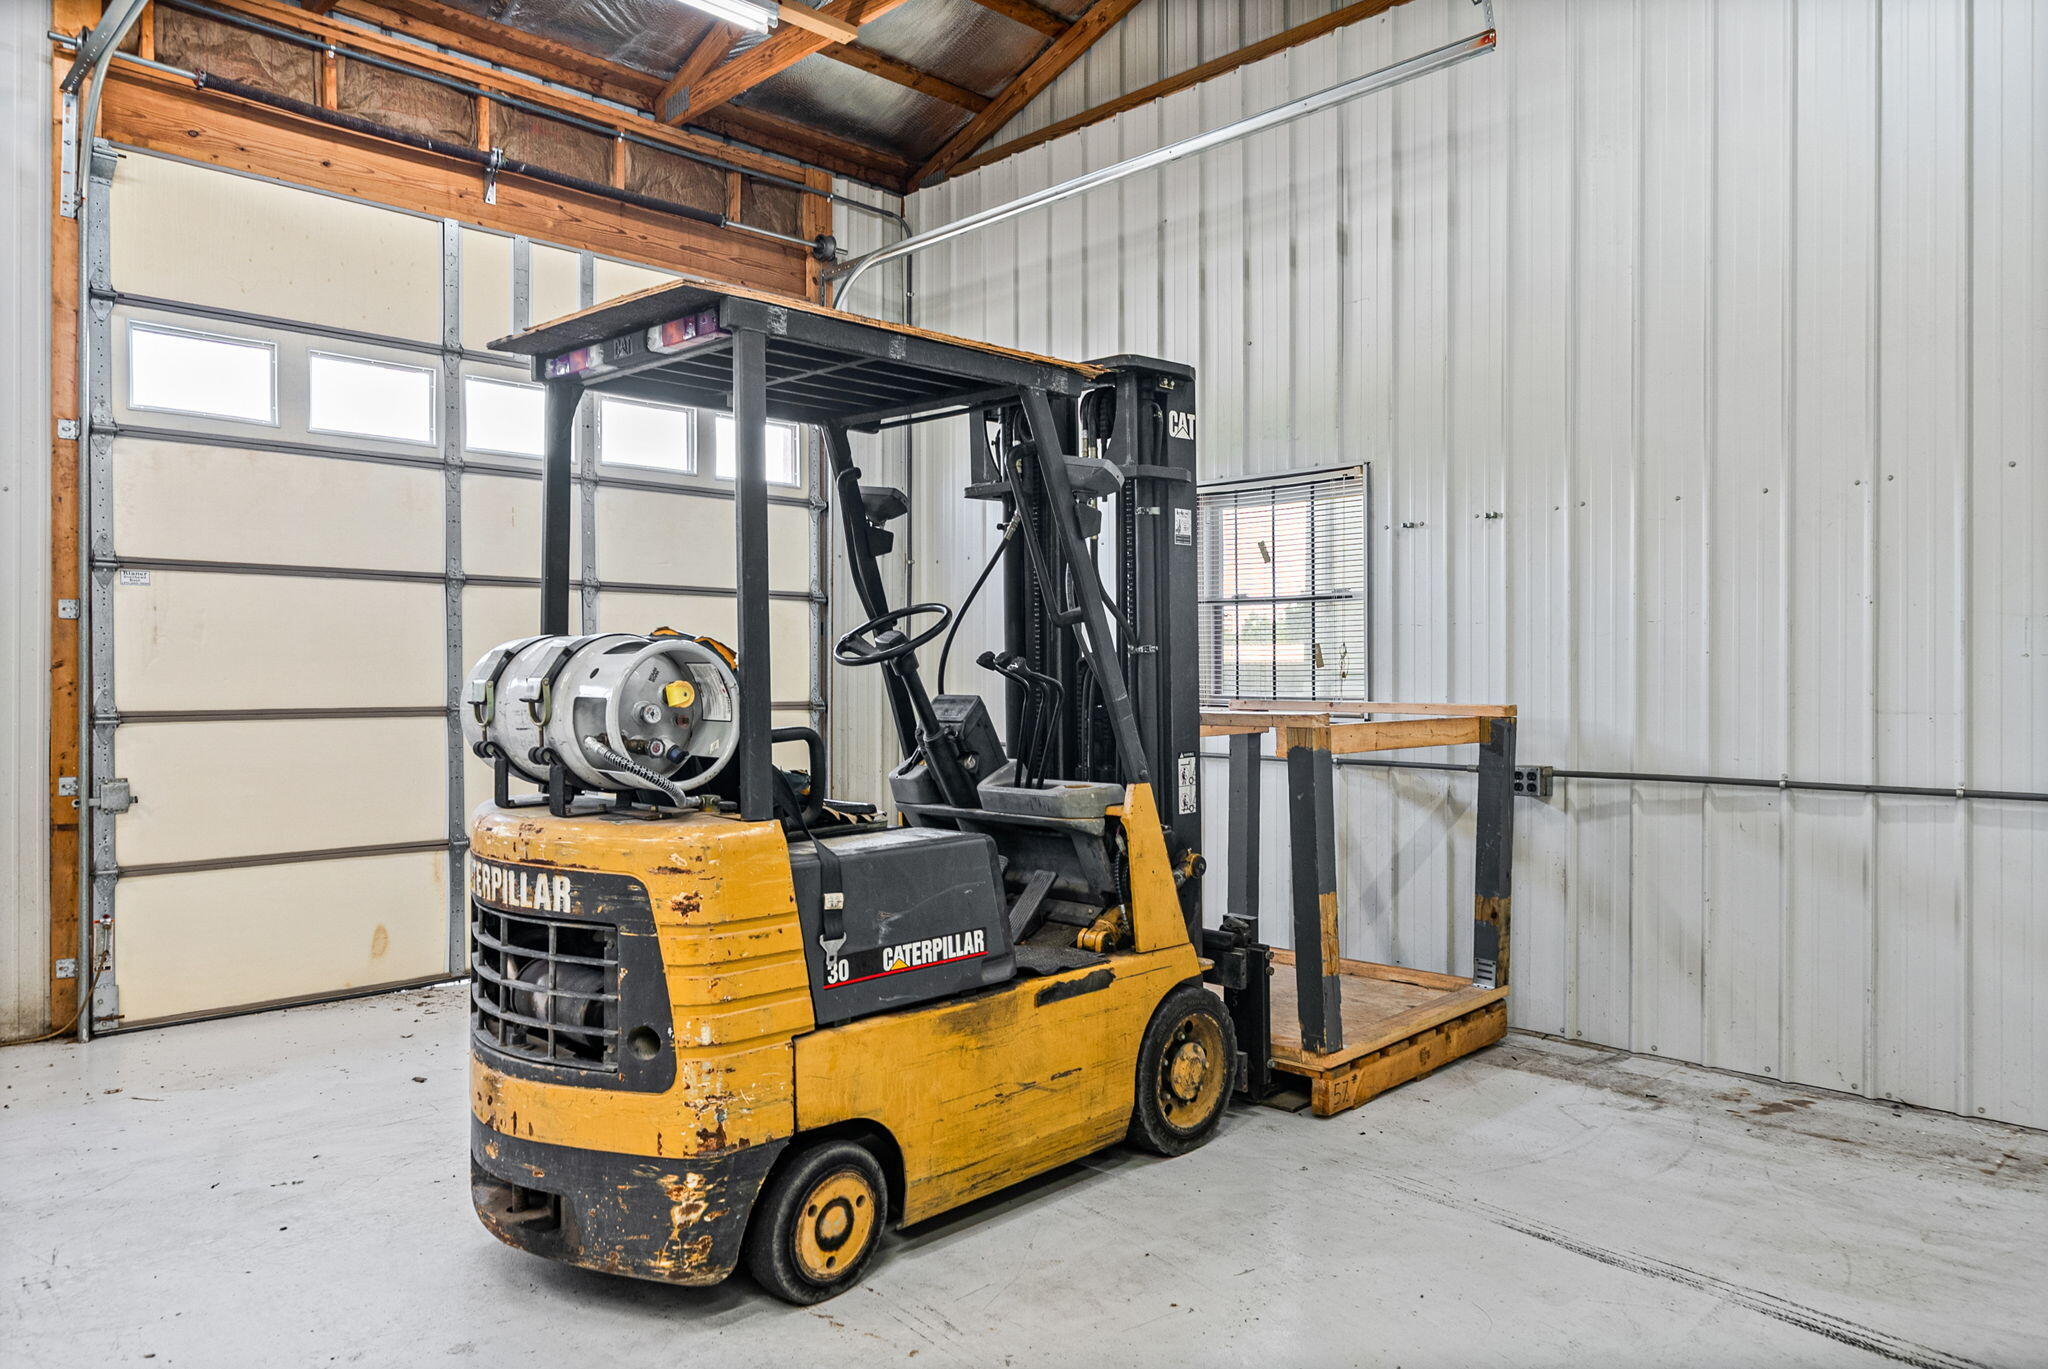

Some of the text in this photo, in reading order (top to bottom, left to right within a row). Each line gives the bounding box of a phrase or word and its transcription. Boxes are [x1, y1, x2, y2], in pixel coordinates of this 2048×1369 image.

[1168, 409, 1196, 440] CAT
[471, 860, 572, 914] TERPILLAR
[882, 929, 985, 972] CATERPILLAR
[827, 958, 850, 985] 30
